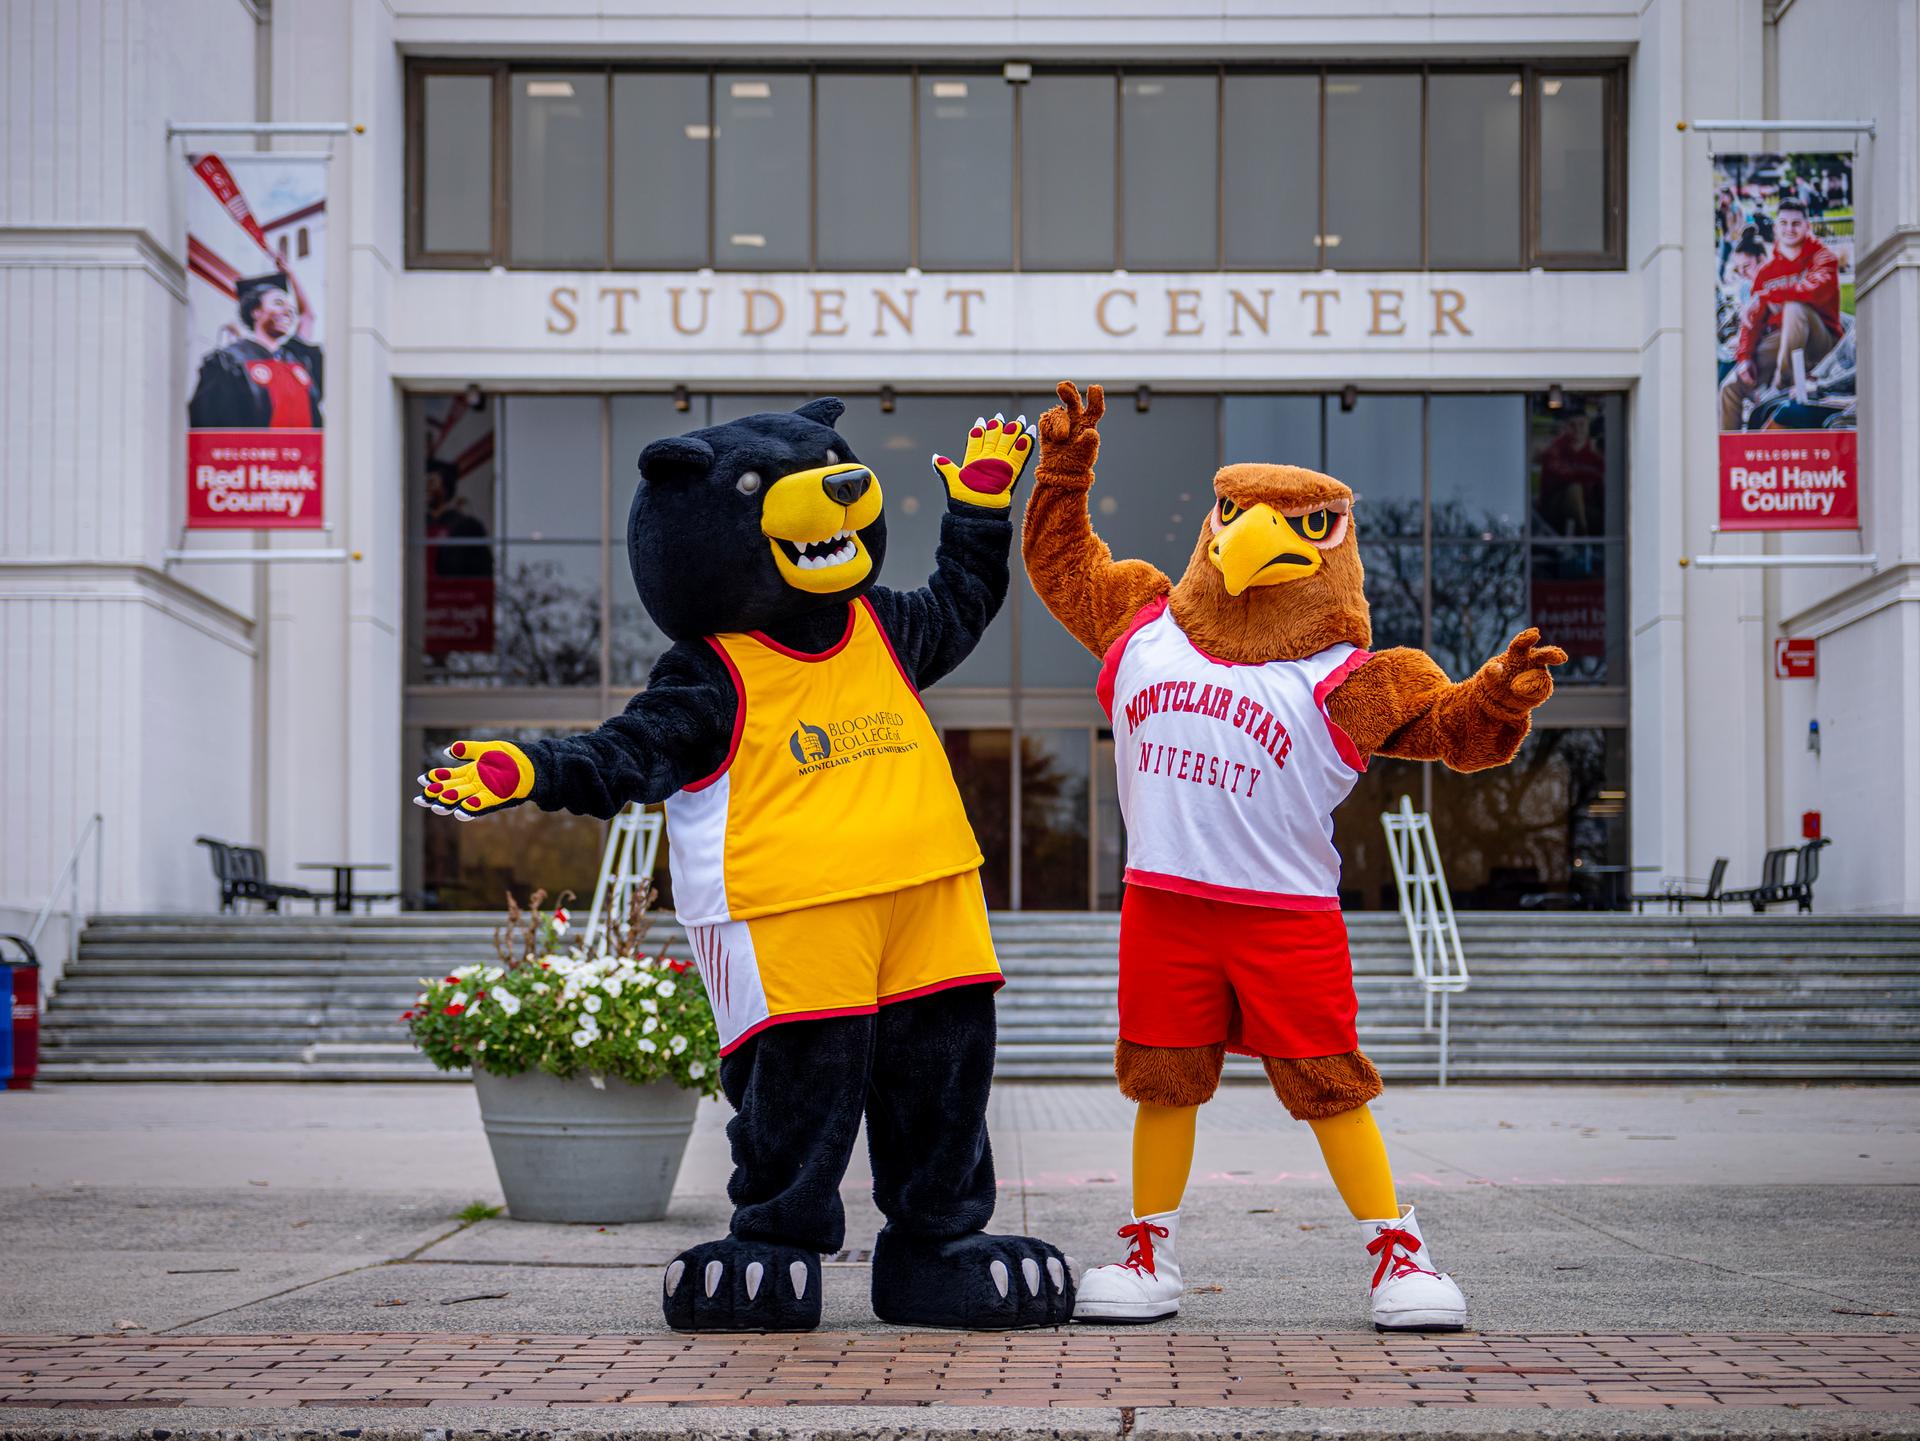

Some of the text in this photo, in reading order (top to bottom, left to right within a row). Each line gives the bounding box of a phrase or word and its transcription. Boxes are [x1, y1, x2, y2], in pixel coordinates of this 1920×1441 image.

[546, 287, 1473, 337] STUDENT CENTER
[1744, 448, 1831, 461] WELCOME TO
[196, 465, 317, 490] Red Hawk
[1730, 465, 1847, 490] Red Hawk
[207, 489, 305, 517] Country
[1741, 489, 1835, 515] Country
[828, 711, 904, 737] BLOOMFIELD
[1125, 681, 1293, 770] MONTCLAIR STATE
[833, 727, 892, 752] COLLEGE
[798, 756, 850, 776] MONTCLAIR
[852, 748, 876, 761] STATE
[1138, 742, 1261, 798] NIVERSITY
